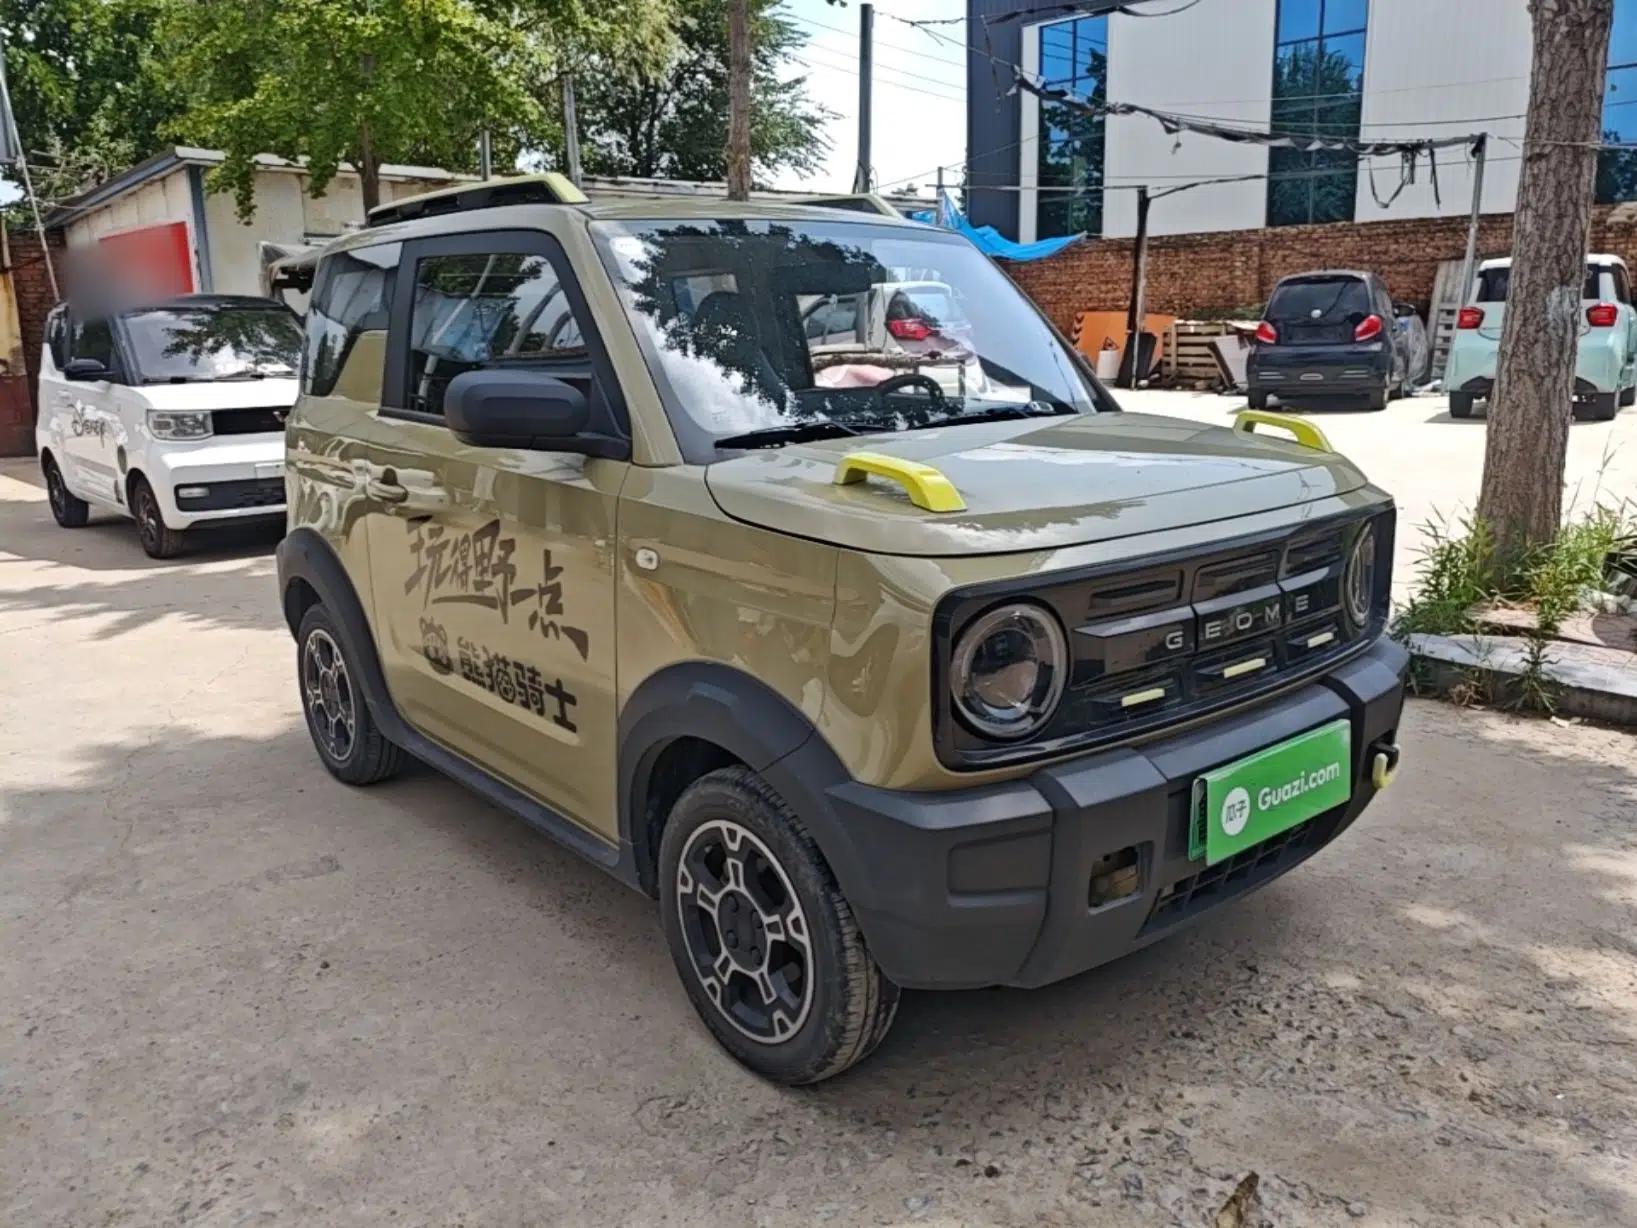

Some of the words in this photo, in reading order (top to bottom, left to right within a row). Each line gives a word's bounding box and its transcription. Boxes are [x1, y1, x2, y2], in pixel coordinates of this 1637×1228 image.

[405, 515, 589, 662] 玩得野一点
[1165, 594, 1309, 649] GEOME
[457, 636, 577, 733] 熊猫骑士
[1258, 762, 1340, 810] Guazi.com
